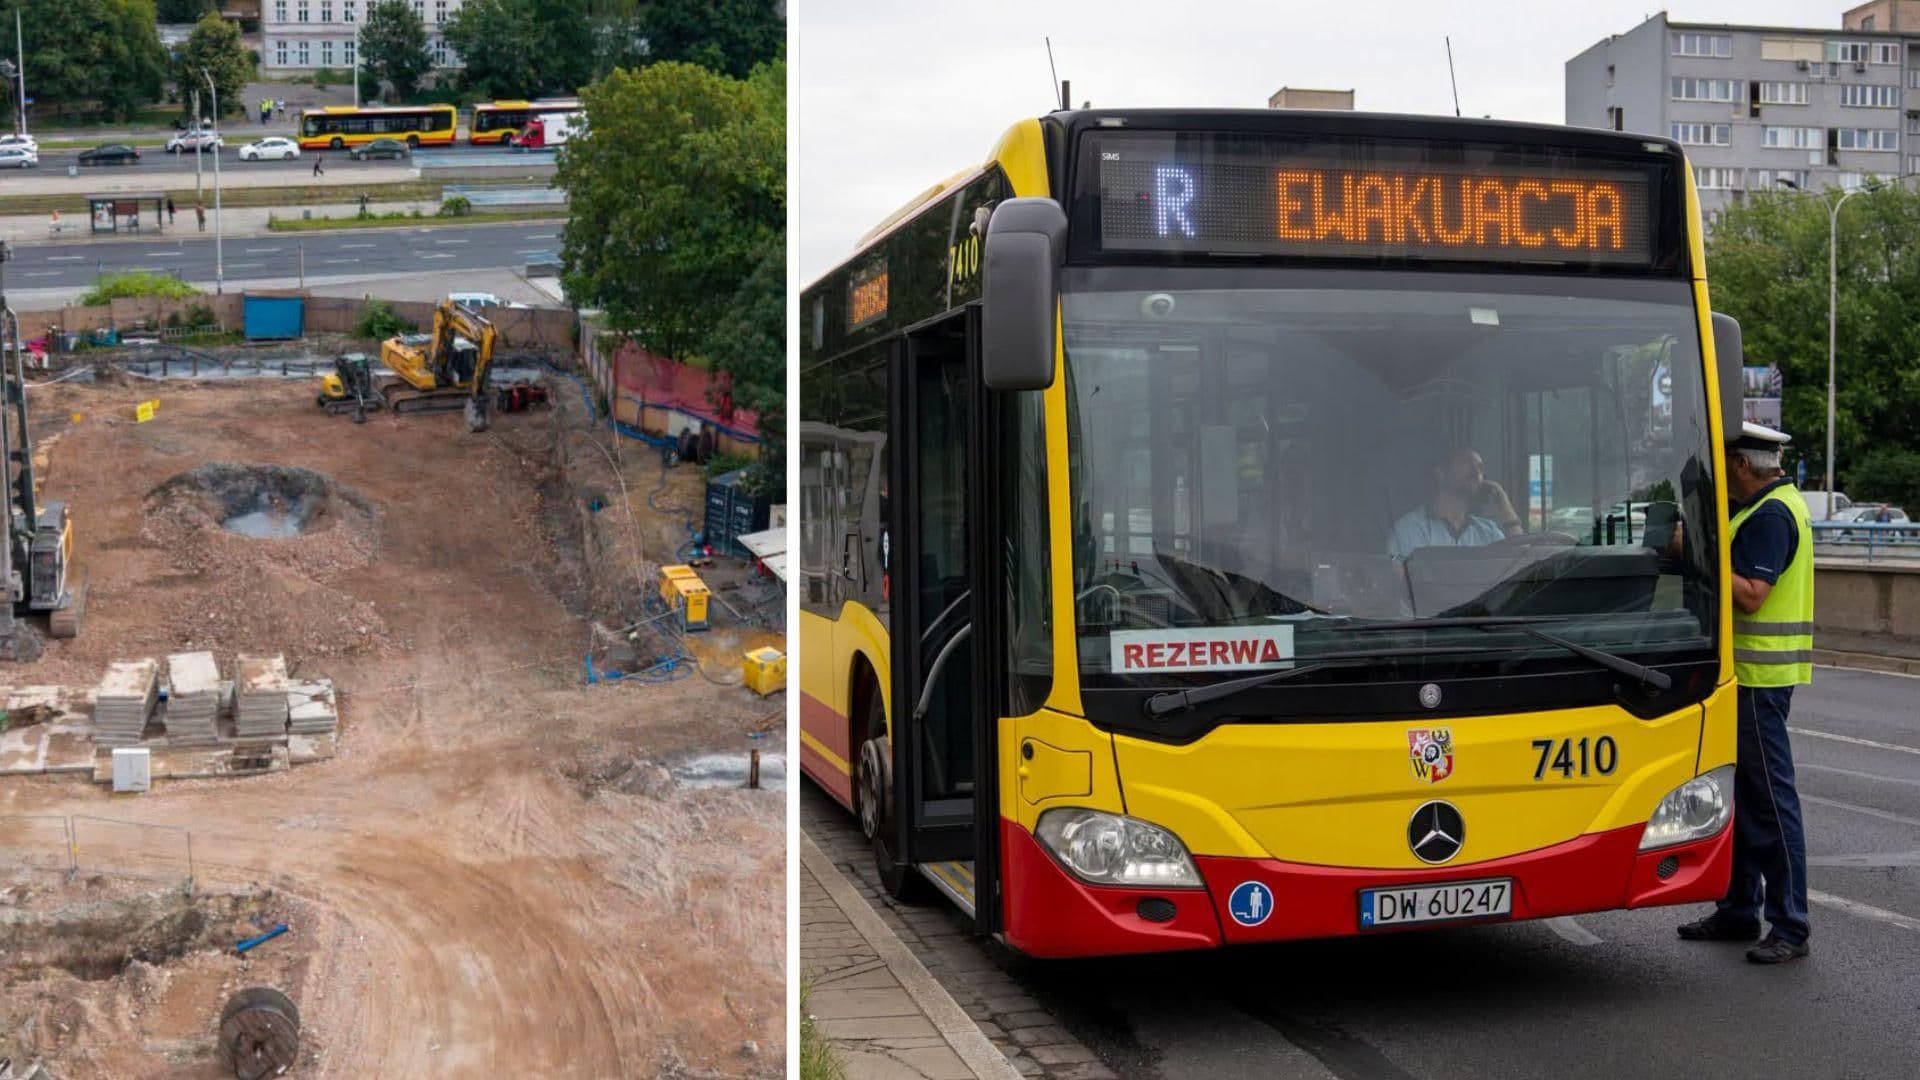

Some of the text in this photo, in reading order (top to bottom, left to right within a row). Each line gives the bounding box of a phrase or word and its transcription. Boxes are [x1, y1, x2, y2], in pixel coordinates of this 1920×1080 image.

[1156, 167, 1623, 249] R EWAKUACJA
[950, 236, 979, 284] 7410
[1123, 639, 1280, 668] REZERWA
[1532, 735, 1618, 781] 7410
[1379, 884, 1507, 920] DW 6U247
